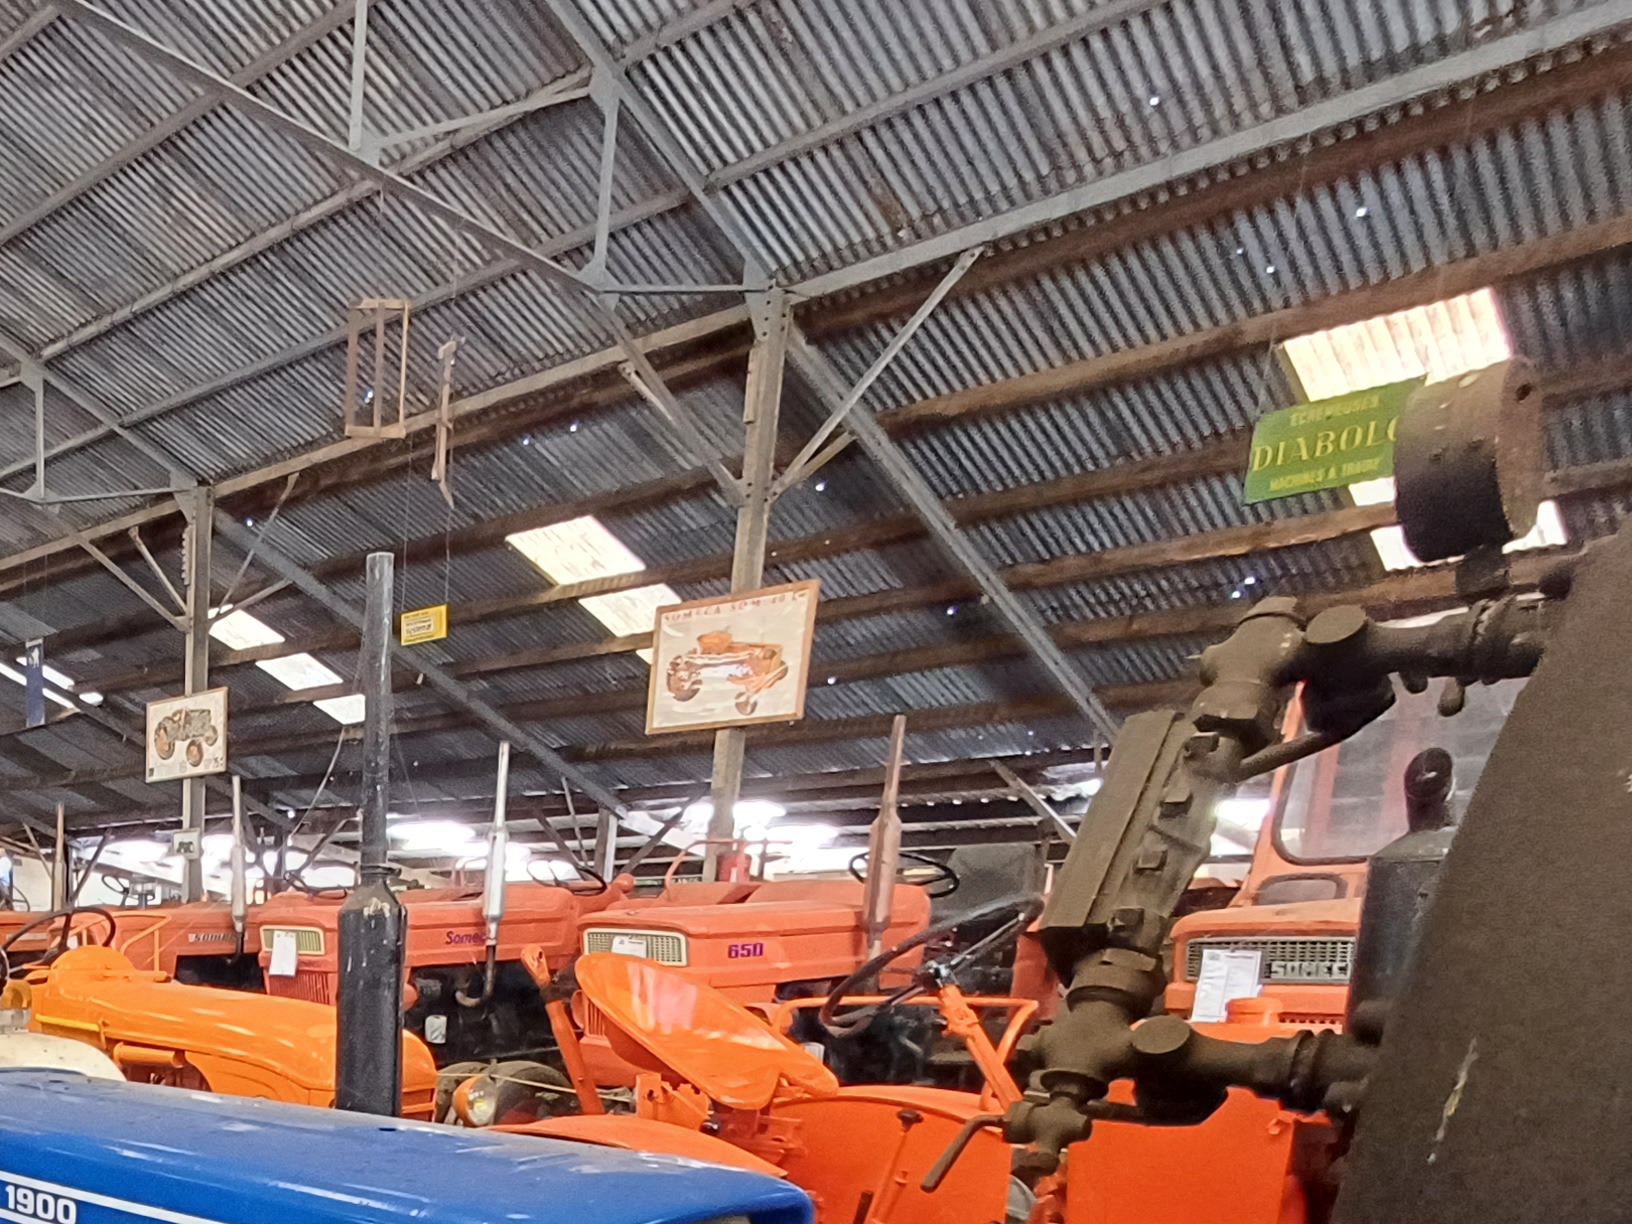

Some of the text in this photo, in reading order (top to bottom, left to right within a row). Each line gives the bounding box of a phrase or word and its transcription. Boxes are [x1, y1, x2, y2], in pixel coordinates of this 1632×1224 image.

[445, 931, 486, 946] Somec
[728, 942, 764, 958] 650
[1270, 962, 1350, 978] SOMEC
